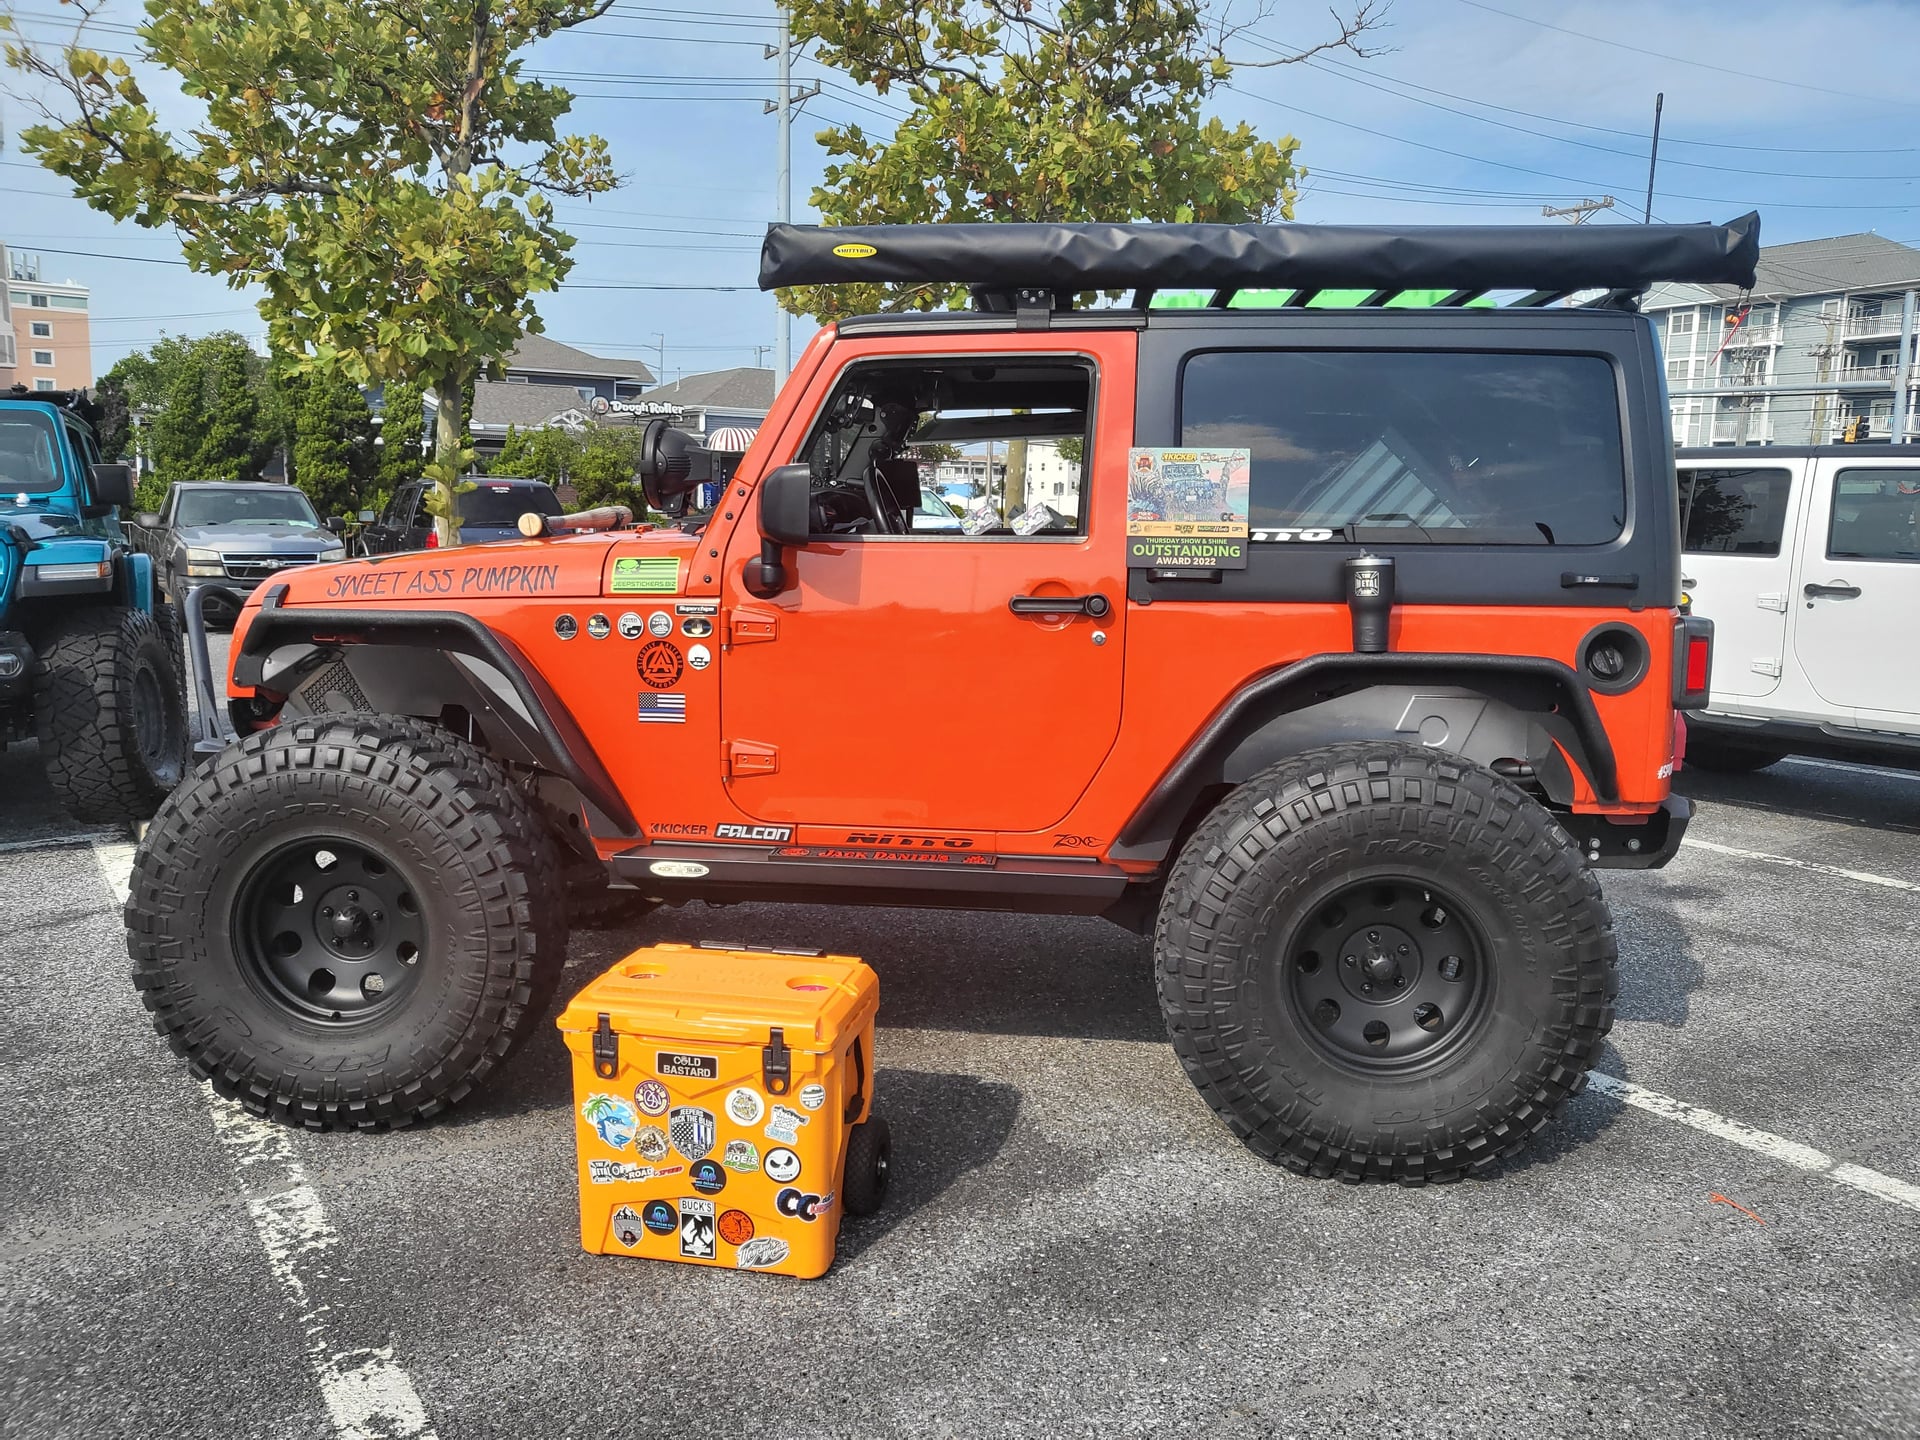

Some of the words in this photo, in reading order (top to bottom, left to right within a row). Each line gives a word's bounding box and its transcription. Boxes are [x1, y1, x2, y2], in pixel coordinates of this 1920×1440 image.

[610, 401, 648, 415] Dough
[648, 402, 684, 414] Roller
[1167, 453, 1197, 462] KICKER
[1250, 528, 1333, 541] TTO
[1133, 544, 1240, 557] OUTSTANDING
[1156, 557, 1191, 565] AWARD
[1192, 558, 1216, 566] 2022
[327, 571, 407, 597] SWEET
[406, 569, 455, 594] ASS
[461, 565, 559, 594] PUMPKIN
[660, 823, 708, 835] KICKER
[717, 824, 791, 841] FALCON
[847, 832, 974, 848] NITTO
[1053, 834, 1106, 848] ZONE
[673, 1056, 701, 1066] COLD
[663, 1064, 711, 1077] BASTARD
[726, 1153, 758, 1164] JOE'S
[682, 1200, 712, 1212] BUCK'S
